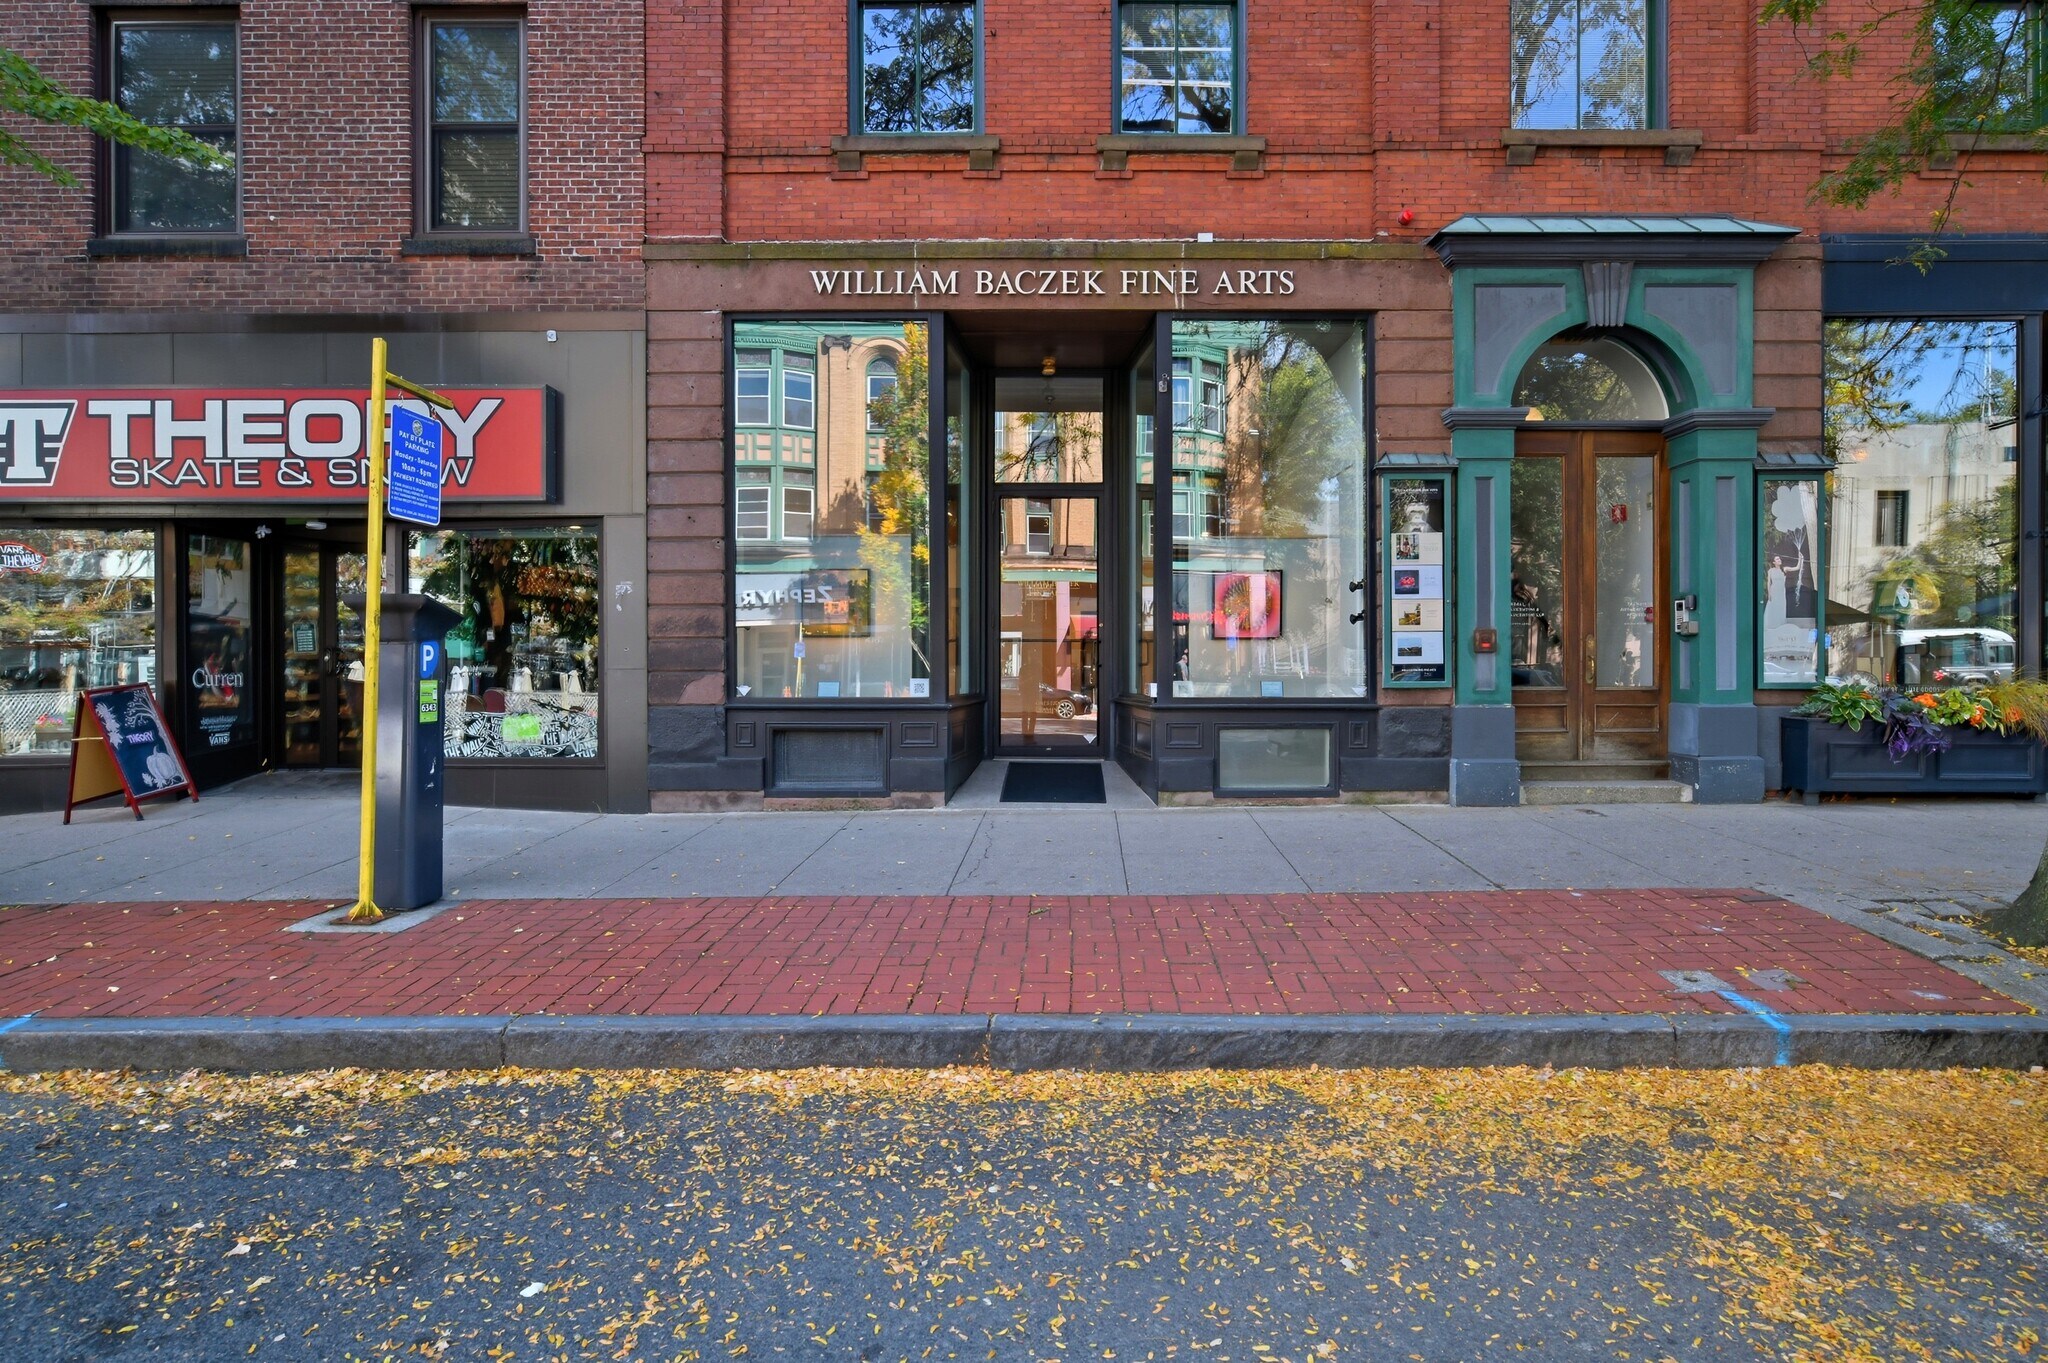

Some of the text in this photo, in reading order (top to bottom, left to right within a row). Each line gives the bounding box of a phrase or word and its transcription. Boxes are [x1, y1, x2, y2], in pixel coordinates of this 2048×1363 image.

[810, 270, 1295, 295] WILLIAM BACZEK FINE ARTS
[110, 458, 474, 486] SKATE & SNW
[422, 644, 435, 672] P
